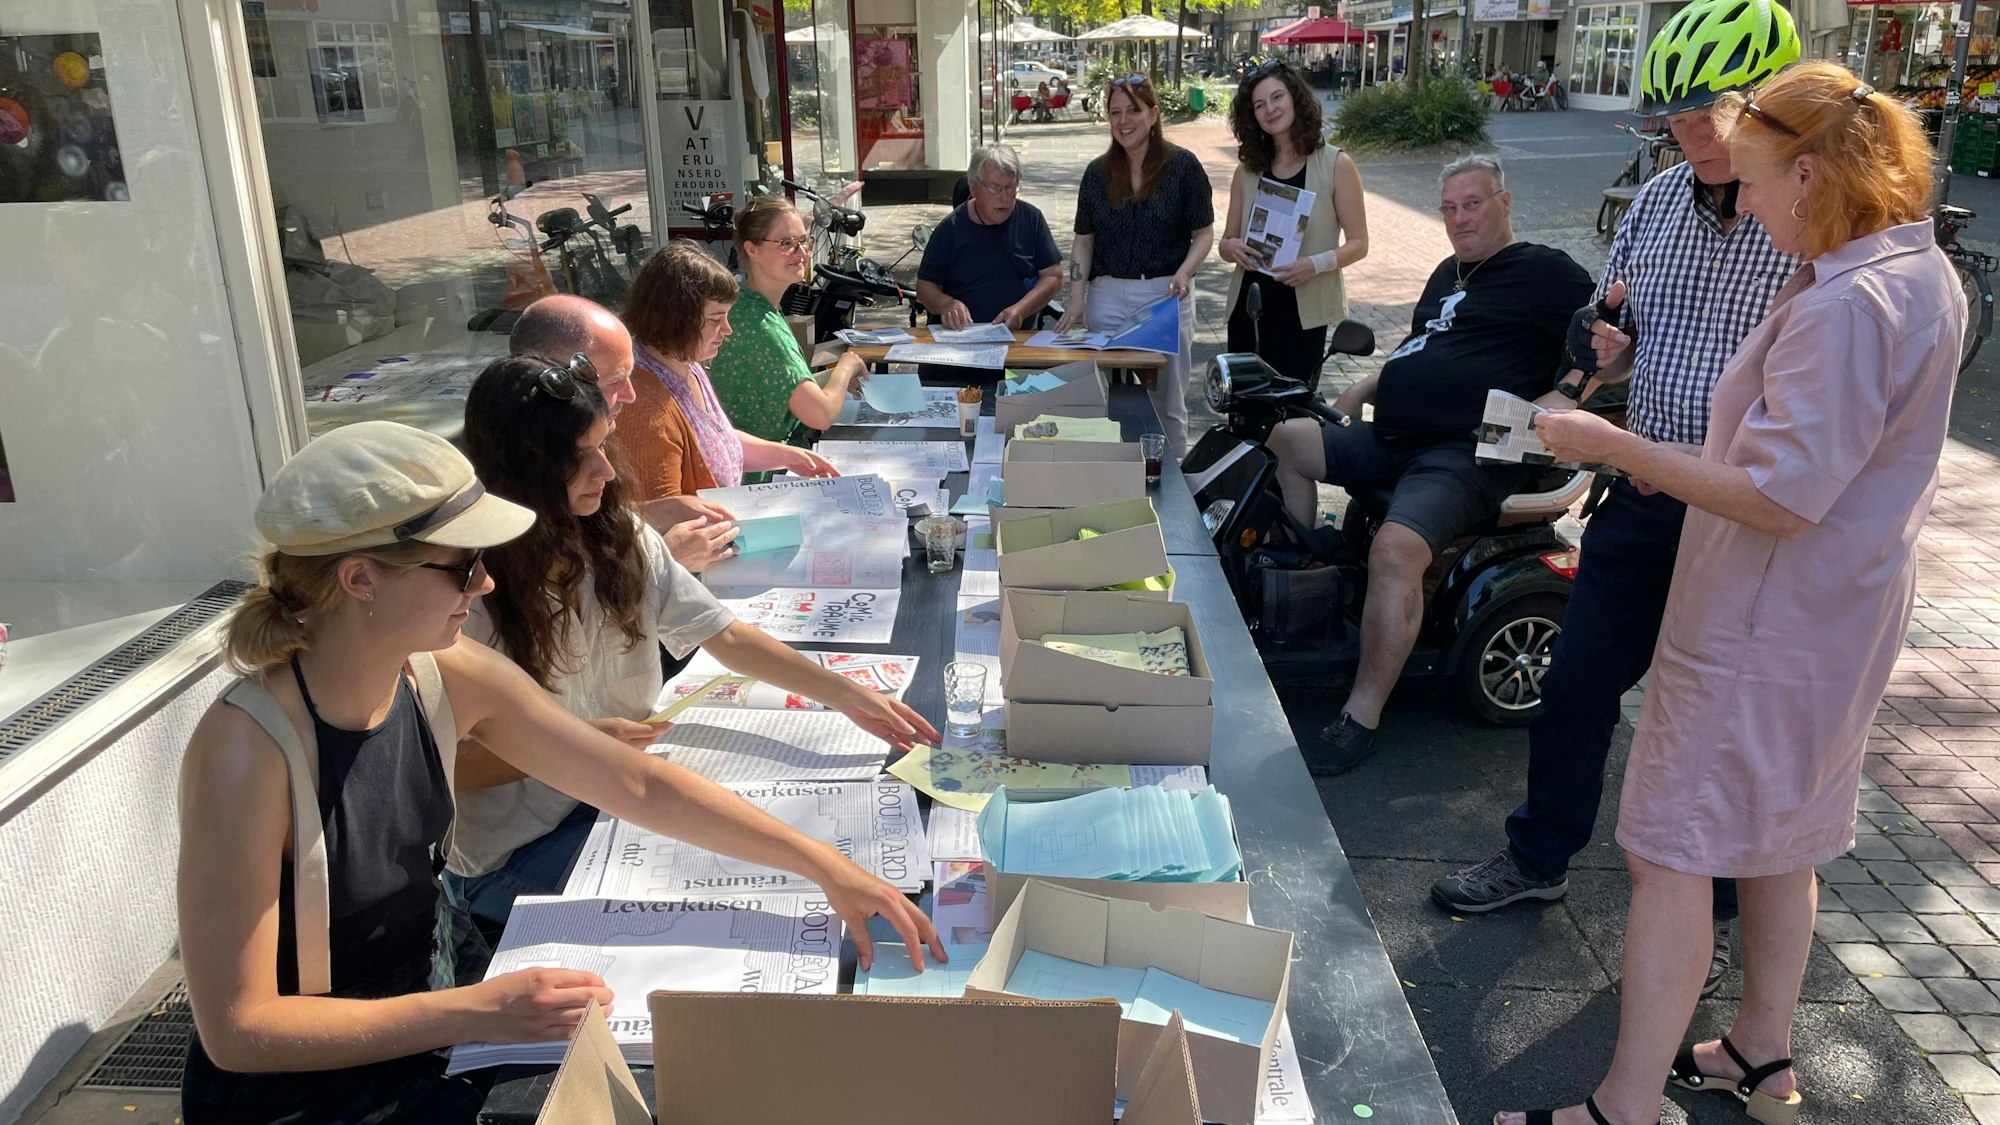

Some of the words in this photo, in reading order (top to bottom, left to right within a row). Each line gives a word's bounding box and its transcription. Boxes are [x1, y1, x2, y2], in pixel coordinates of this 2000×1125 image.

[684, 106, 704, 131] V
[683, 155, 714, 165] ERU
[678, 169, 722, 178] NSERD
[675, 181, 726, 189] ERDUBIS
[748, 479, 836, 492] Leverkusen
[734, 786, 842, 798] verkusen
[874, 785, 909, 881] BOULEVARD
[620, 843, 648, 867] du?
[601, 895, 763, 915] Leverkusen
[790, 900, 833, 993] BOULEVA
